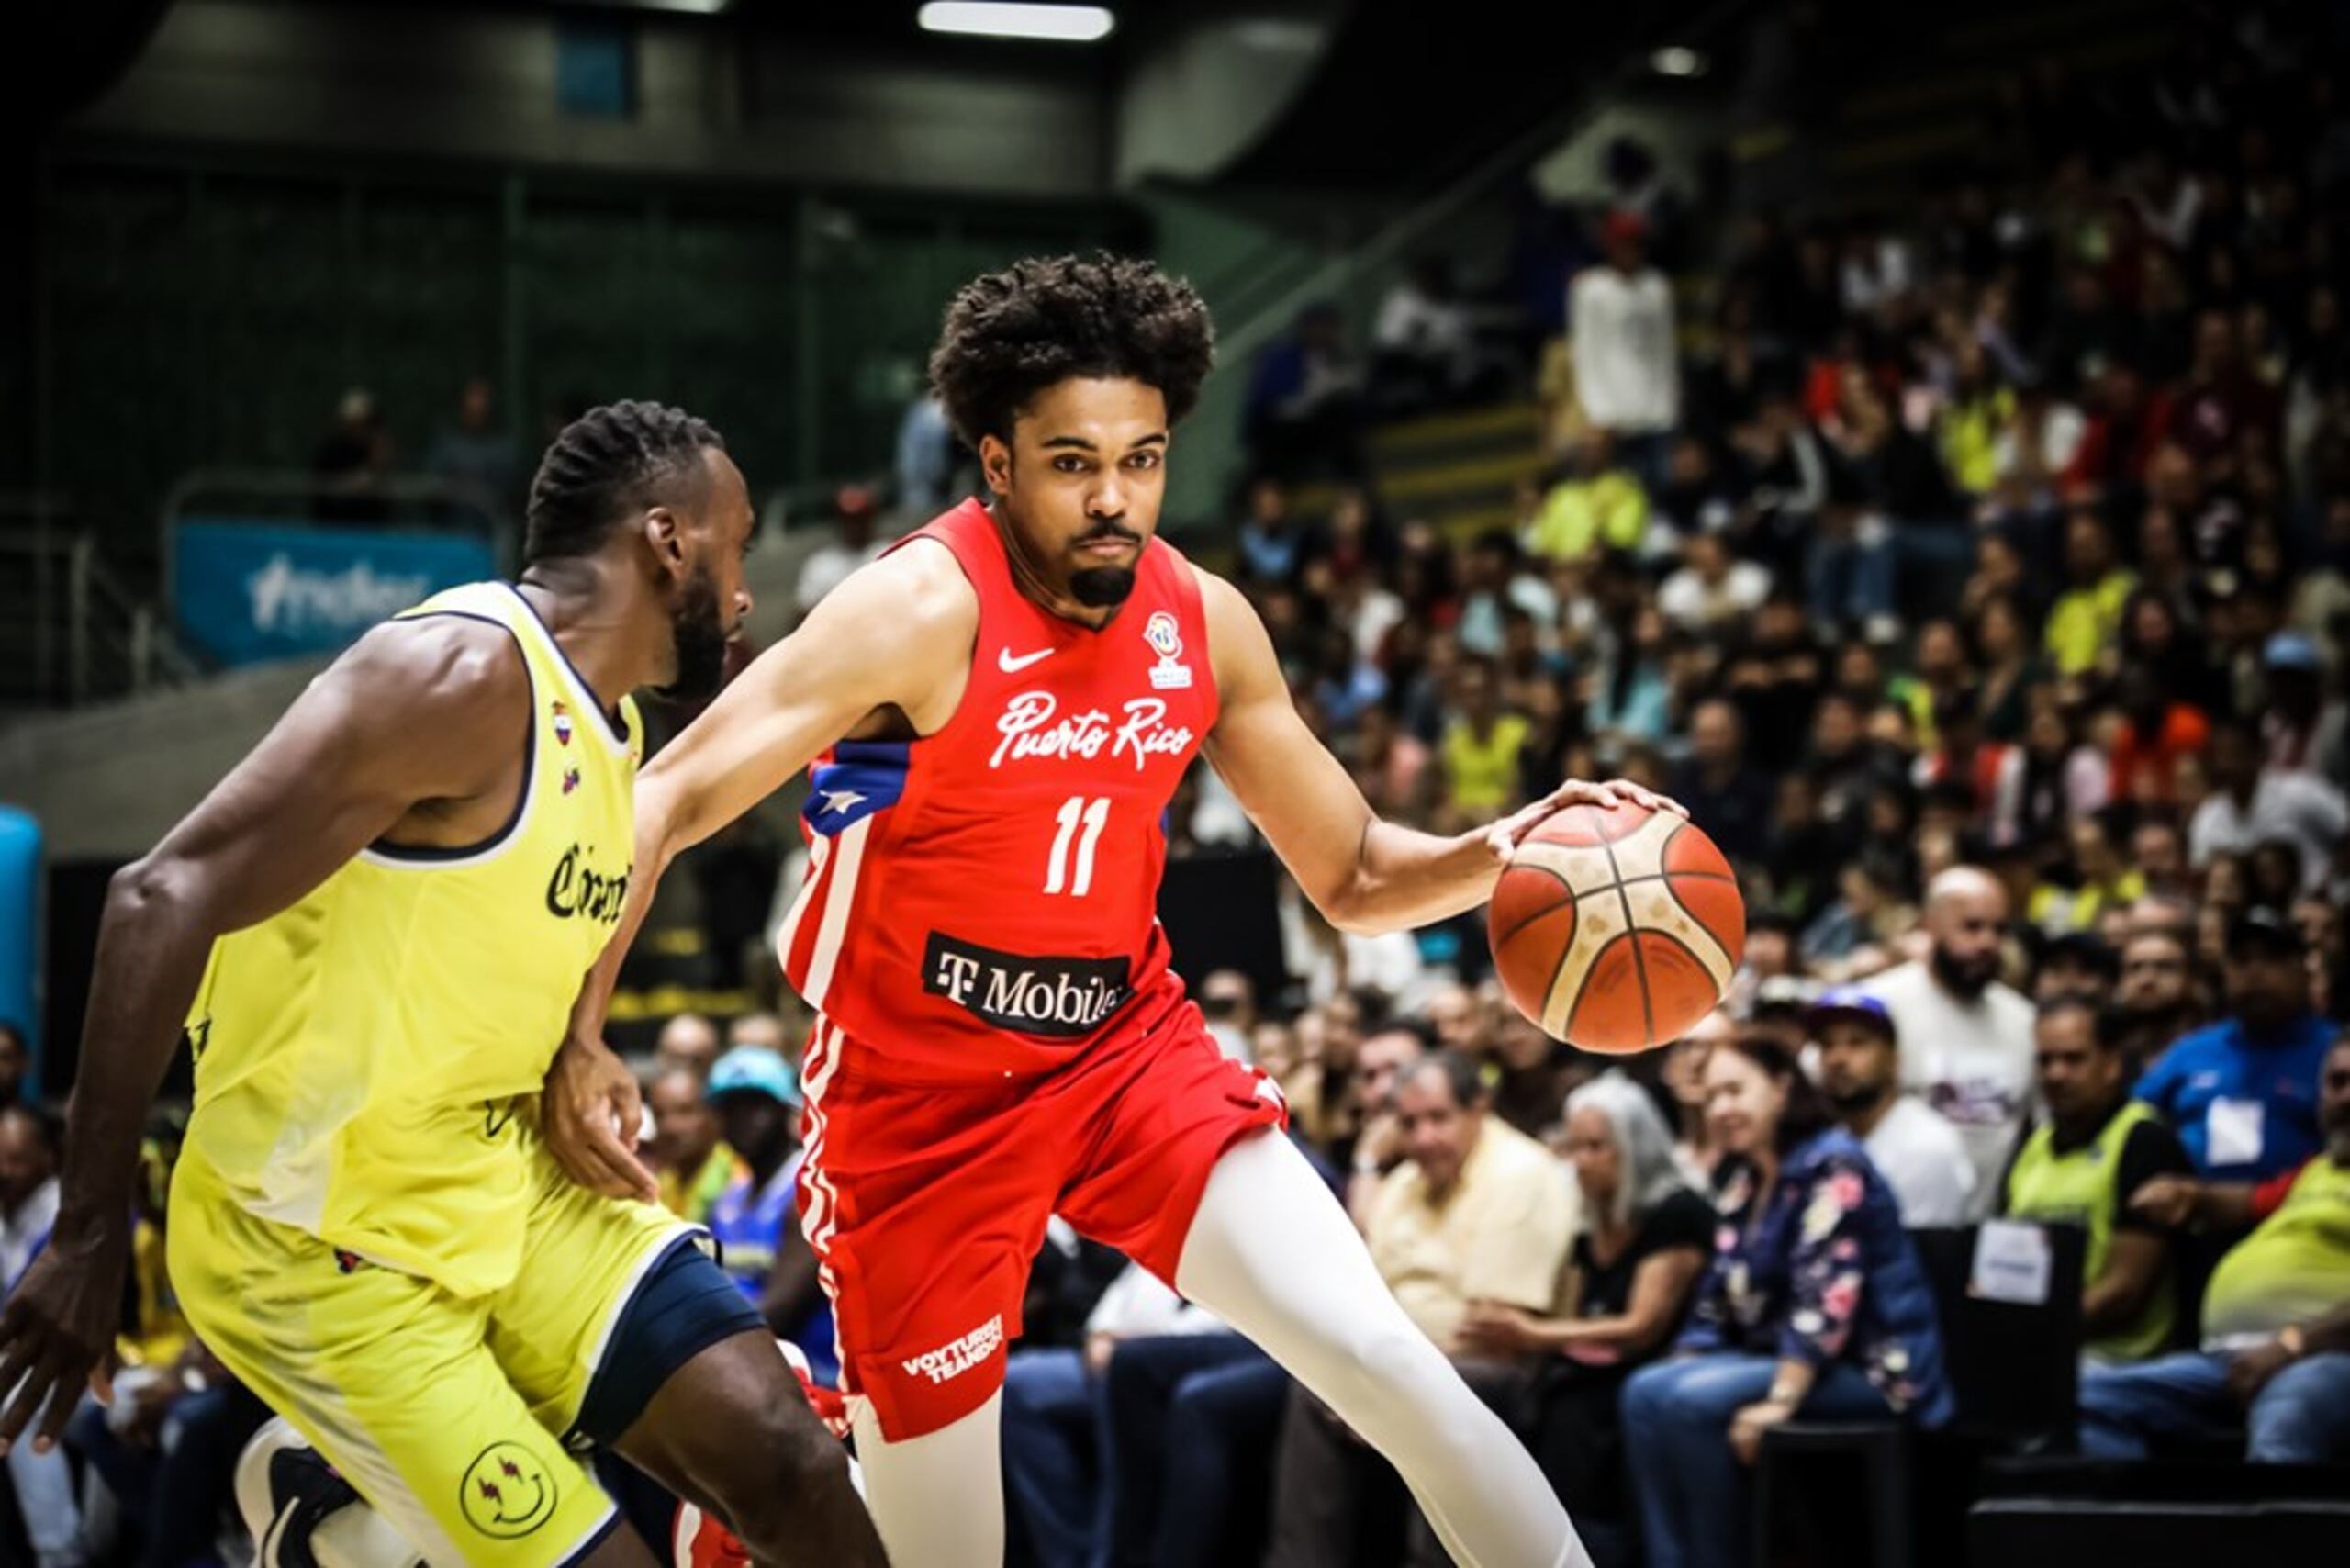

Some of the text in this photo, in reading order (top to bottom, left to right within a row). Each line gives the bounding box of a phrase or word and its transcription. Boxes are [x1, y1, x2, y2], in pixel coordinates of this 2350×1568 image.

[989, 690, 1193, 771] Puerto Rico
[1043, 796, 1112, 896] 11
[982, 968, 1120, 1025] Mobile
